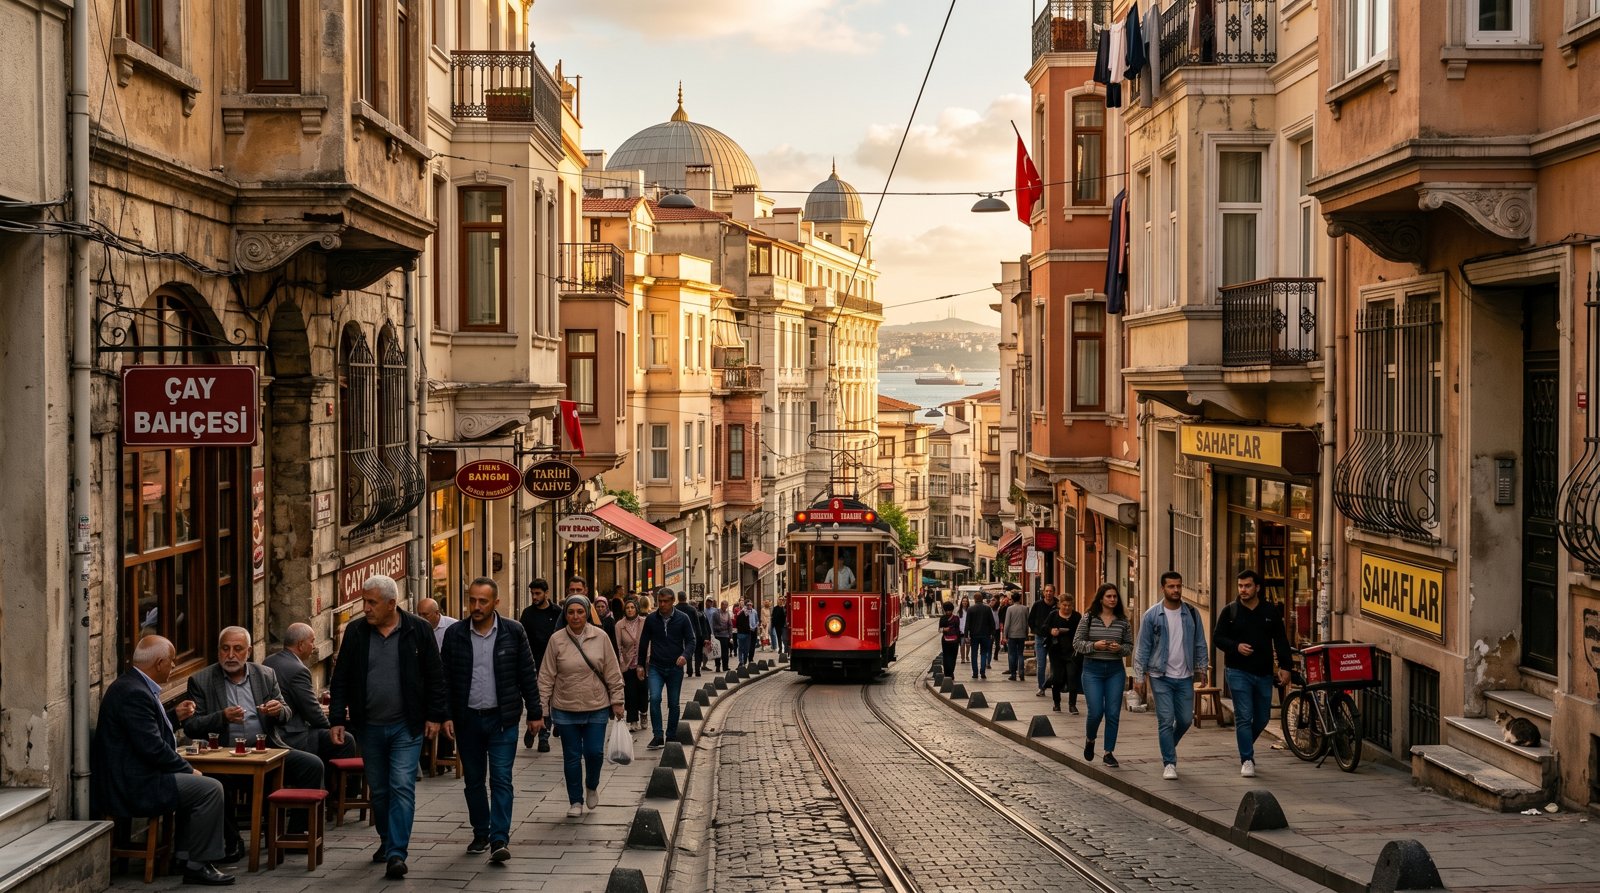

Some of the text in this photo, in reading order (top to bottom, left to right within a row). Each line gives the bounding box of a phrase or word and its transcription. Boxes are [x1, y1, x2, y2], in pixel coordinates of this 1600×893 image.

[165, 377, 216, 405] ÇAY
[134, 405, 247, 439] BAHÇESİ
[1196, 430, 1261, 460] SAHAFLAR
[532, 467, 571, 479] TARİHİ
[532, 481, 572, 491] KAHVE
[1362, 562, 1440, 624] SAHAFLAR
